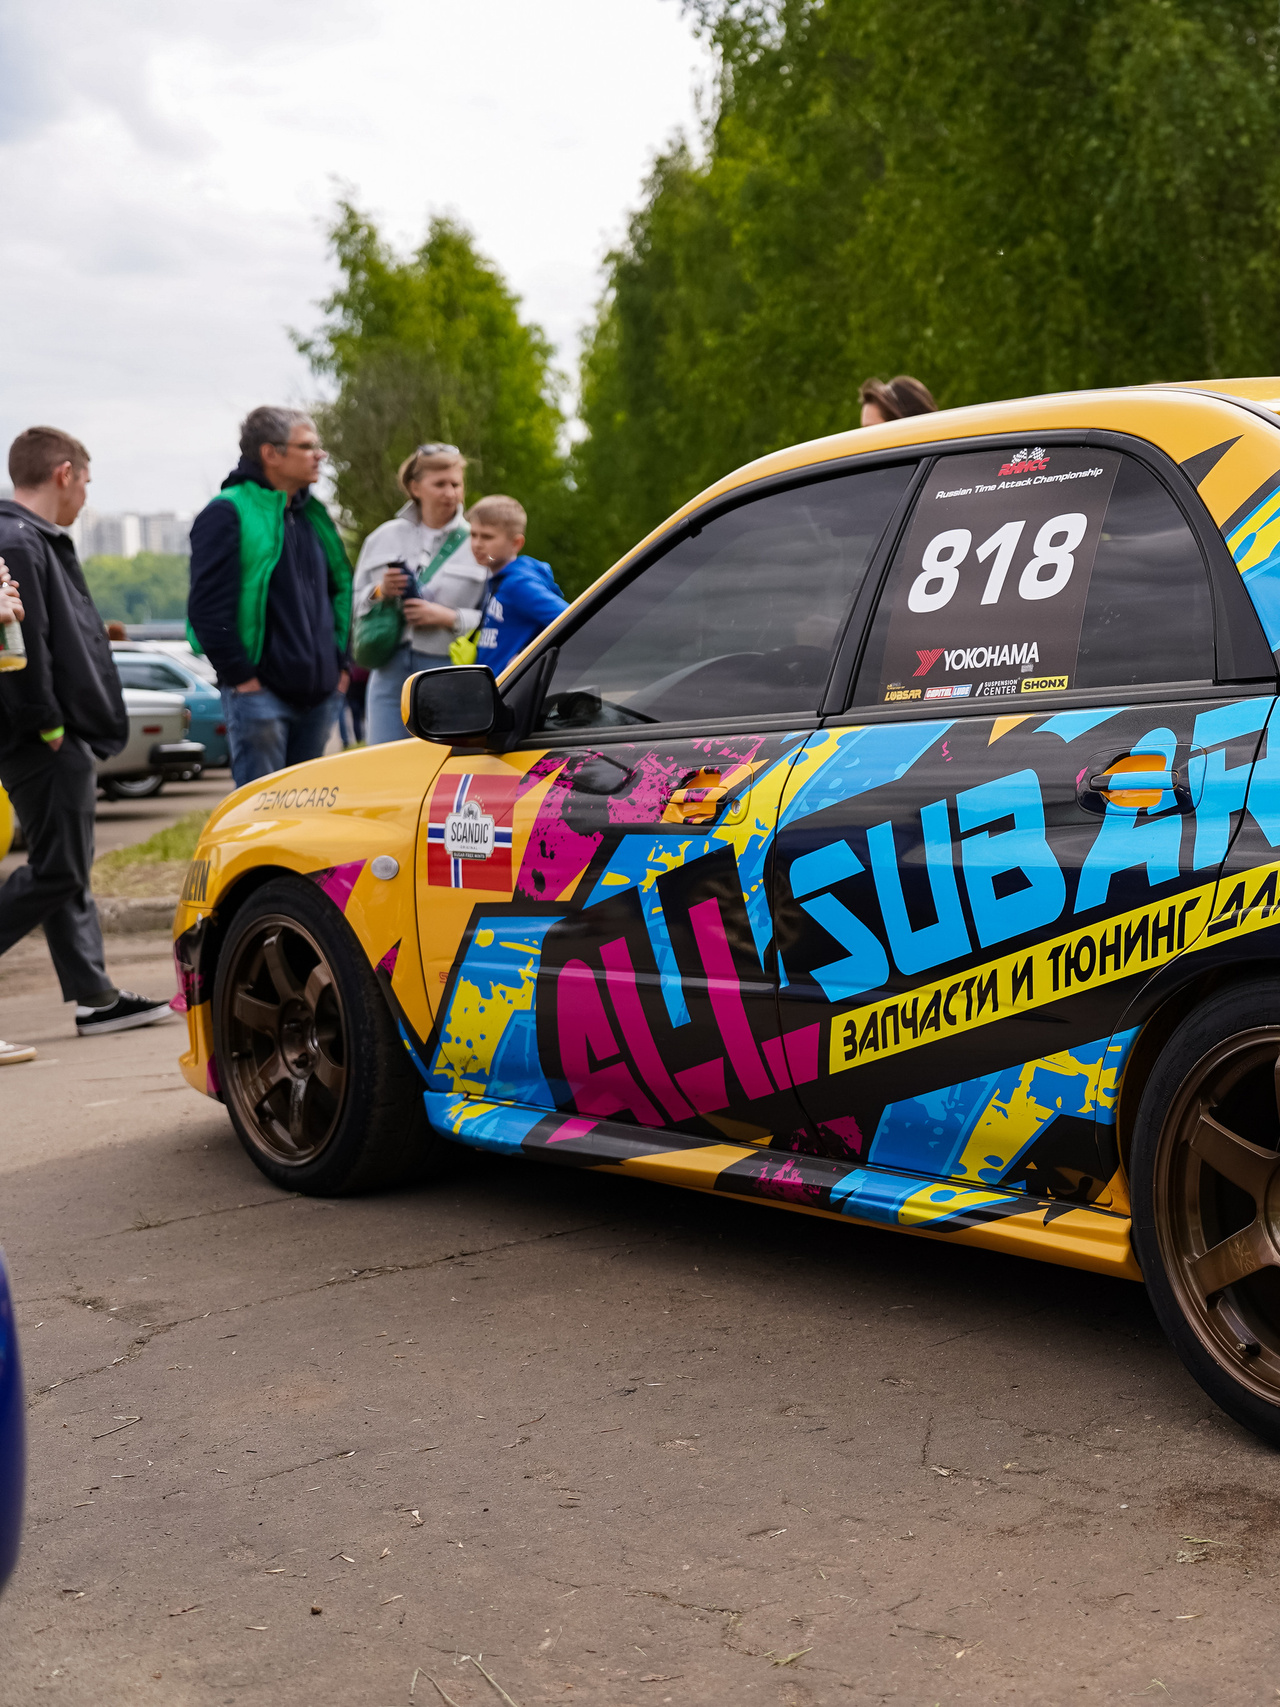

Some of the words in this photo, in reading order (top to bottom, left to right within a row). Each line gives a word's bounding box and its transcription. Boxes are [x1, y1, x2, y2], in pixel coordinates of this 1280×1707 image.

[935, 487, 973, 500] Russian
[975, 484, 997, 494] Time
[997, 477, 1033, 491] Attack
[1033, 467, 1104, 485] Championship
[907, 512, 1089, 614] 818
[943, 641, 1040, 672] YOKOHAMA
[983, 685, 1017, 696] CENTER
[985, 679, 1018, 687] SUSPENSION
[1023, 678, 1066, 690] SHONX
[253, 785, 340, 812] DEMOCARS
[451, 822, 489, 844] SCANDIC
[842, 969, 999, 1062] ЗАПЧАСТИ
[1011, 954, 1035, 1007] И
[1047, 895, 1203, 992] ТЮНИНГ
[556, 896, 821, 1129] ALL
